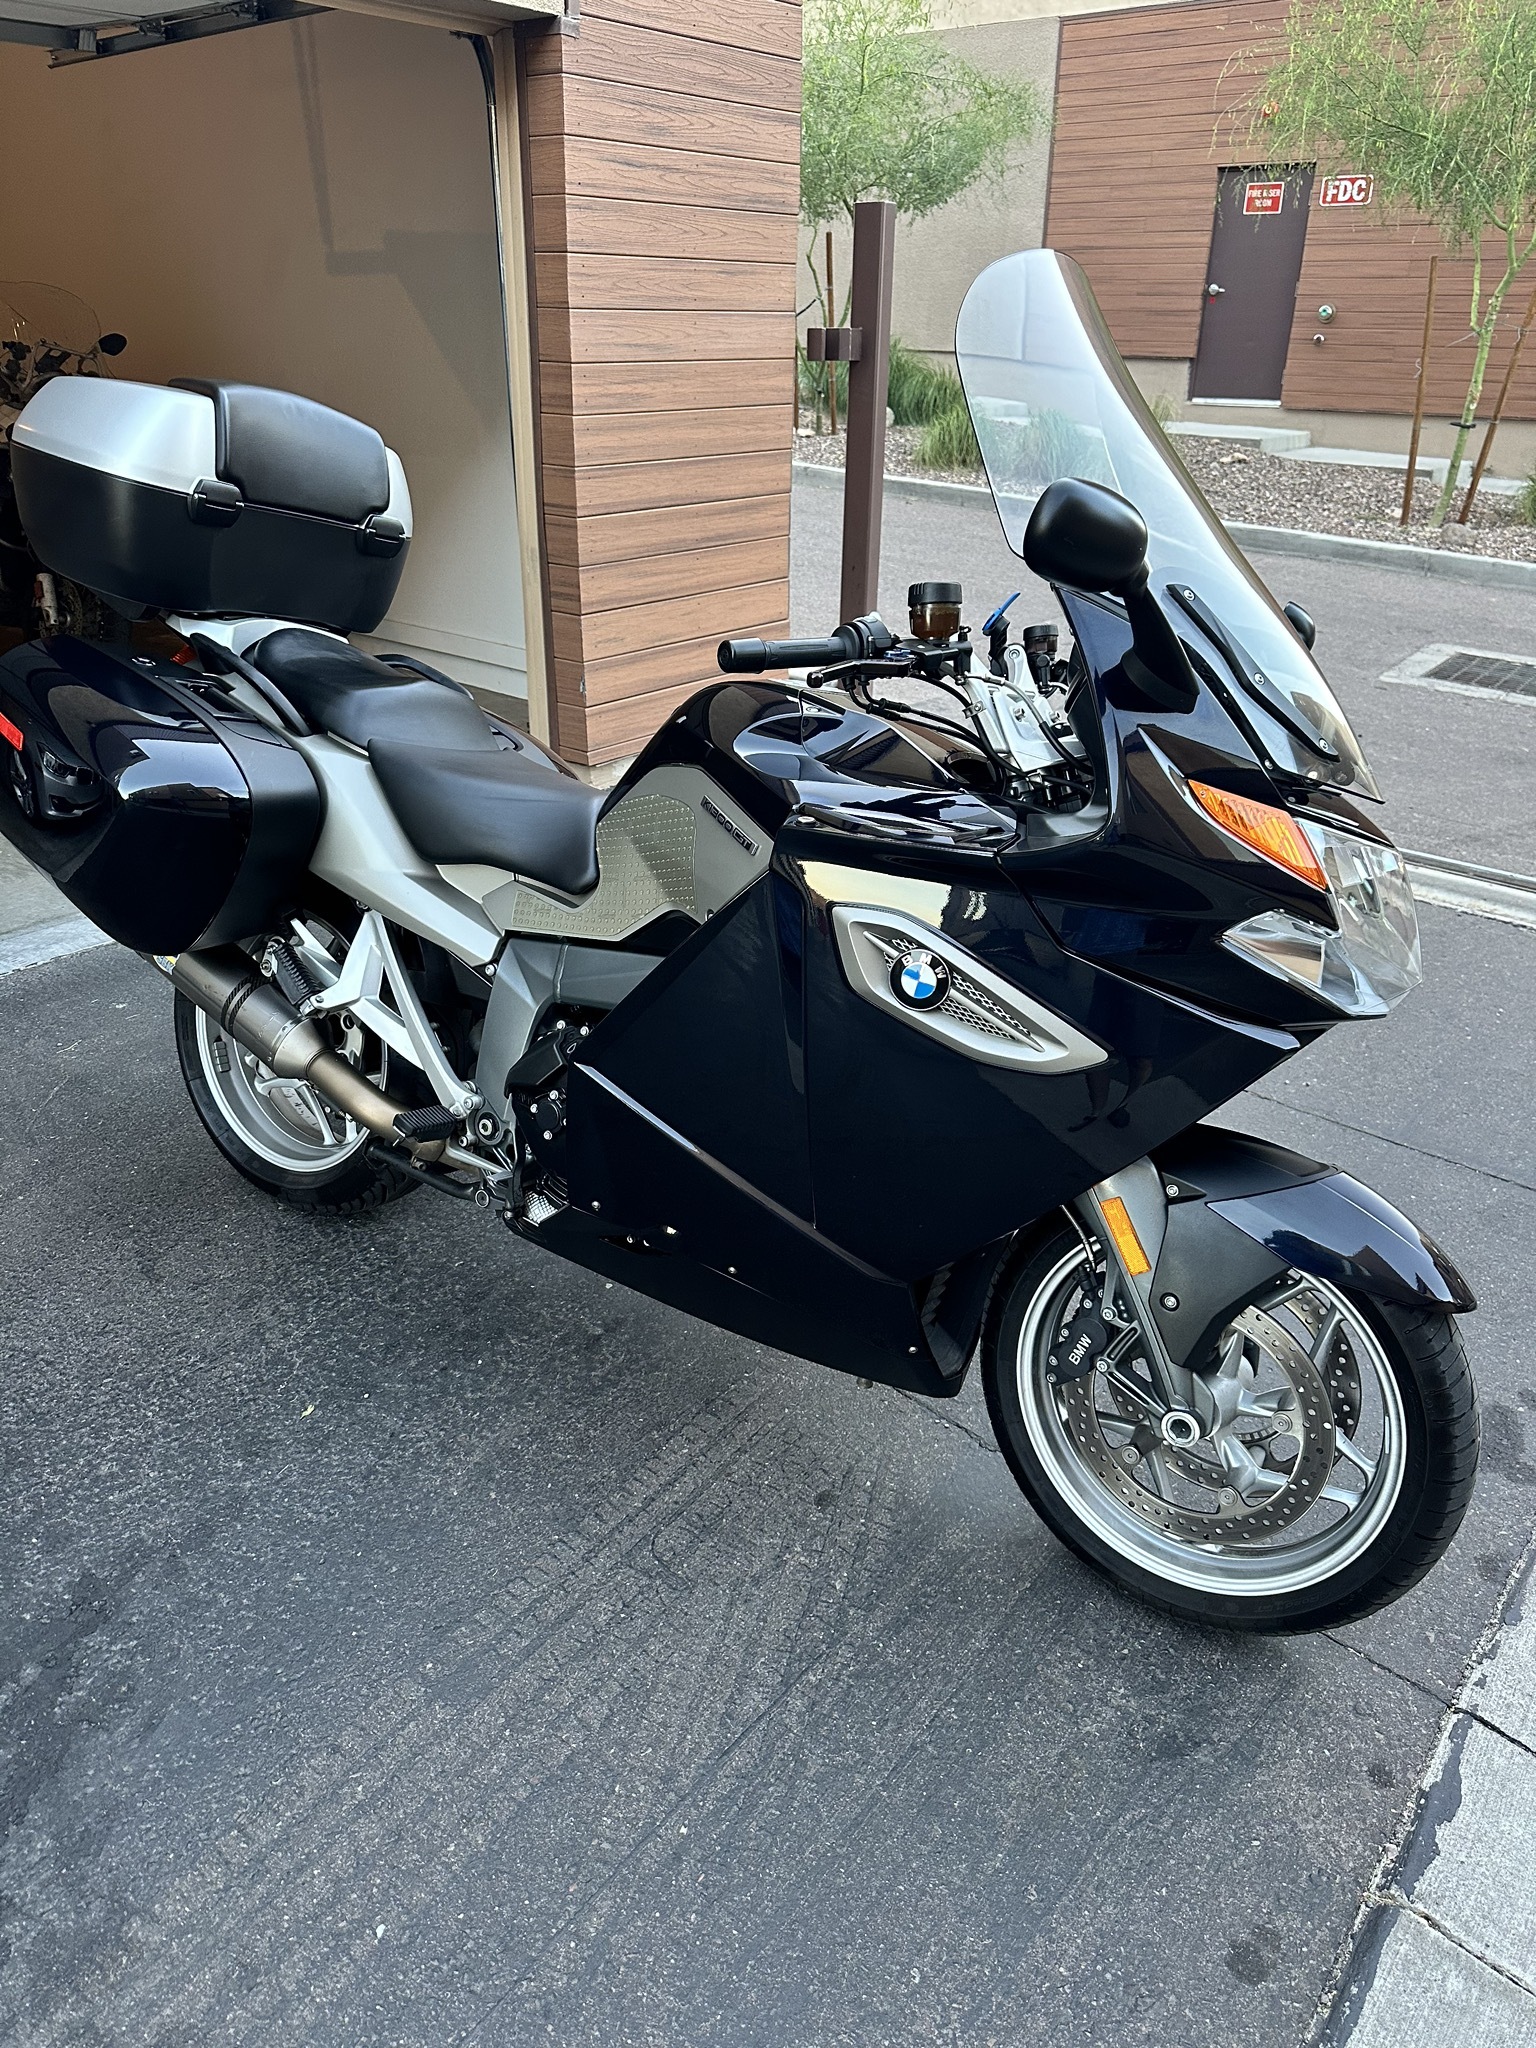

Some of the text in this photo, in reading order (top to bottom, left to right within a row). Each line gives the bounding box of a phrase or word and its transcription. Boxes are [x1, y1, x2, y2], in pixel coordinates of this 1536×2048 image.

[1325, 179, 1367, 202] FDC
[901, 952, 947, 979] BMW
[1068, 1333, 1092, 1366] BMW
